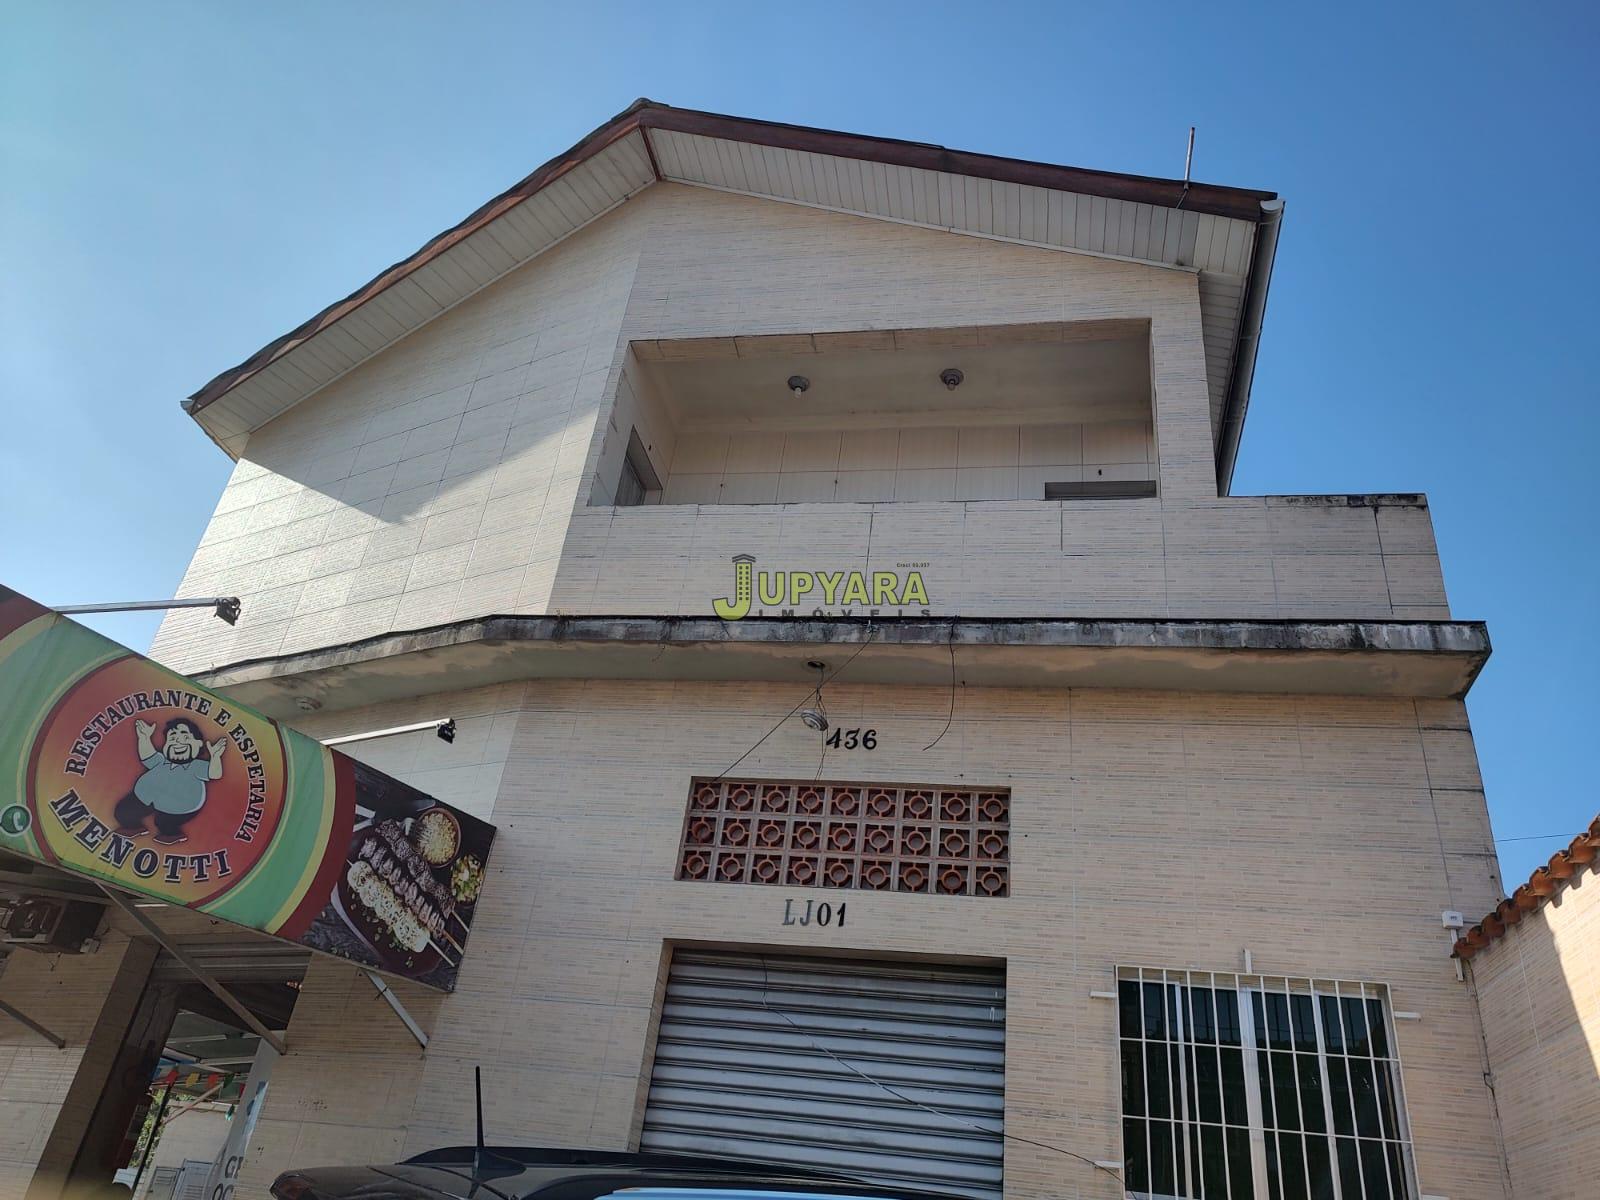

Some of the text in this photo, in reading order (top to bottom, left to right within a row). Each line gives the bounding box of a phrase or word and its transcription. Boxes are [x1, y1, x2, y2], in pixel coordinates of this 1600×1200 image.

[64, 689, 267, 843] RESTAURANTE E ESPETARIA
[826, 727, 878, 750] 436
[48, 789, 232, 882] MENOTTI
[781, 898, 847, 928] LJ01
